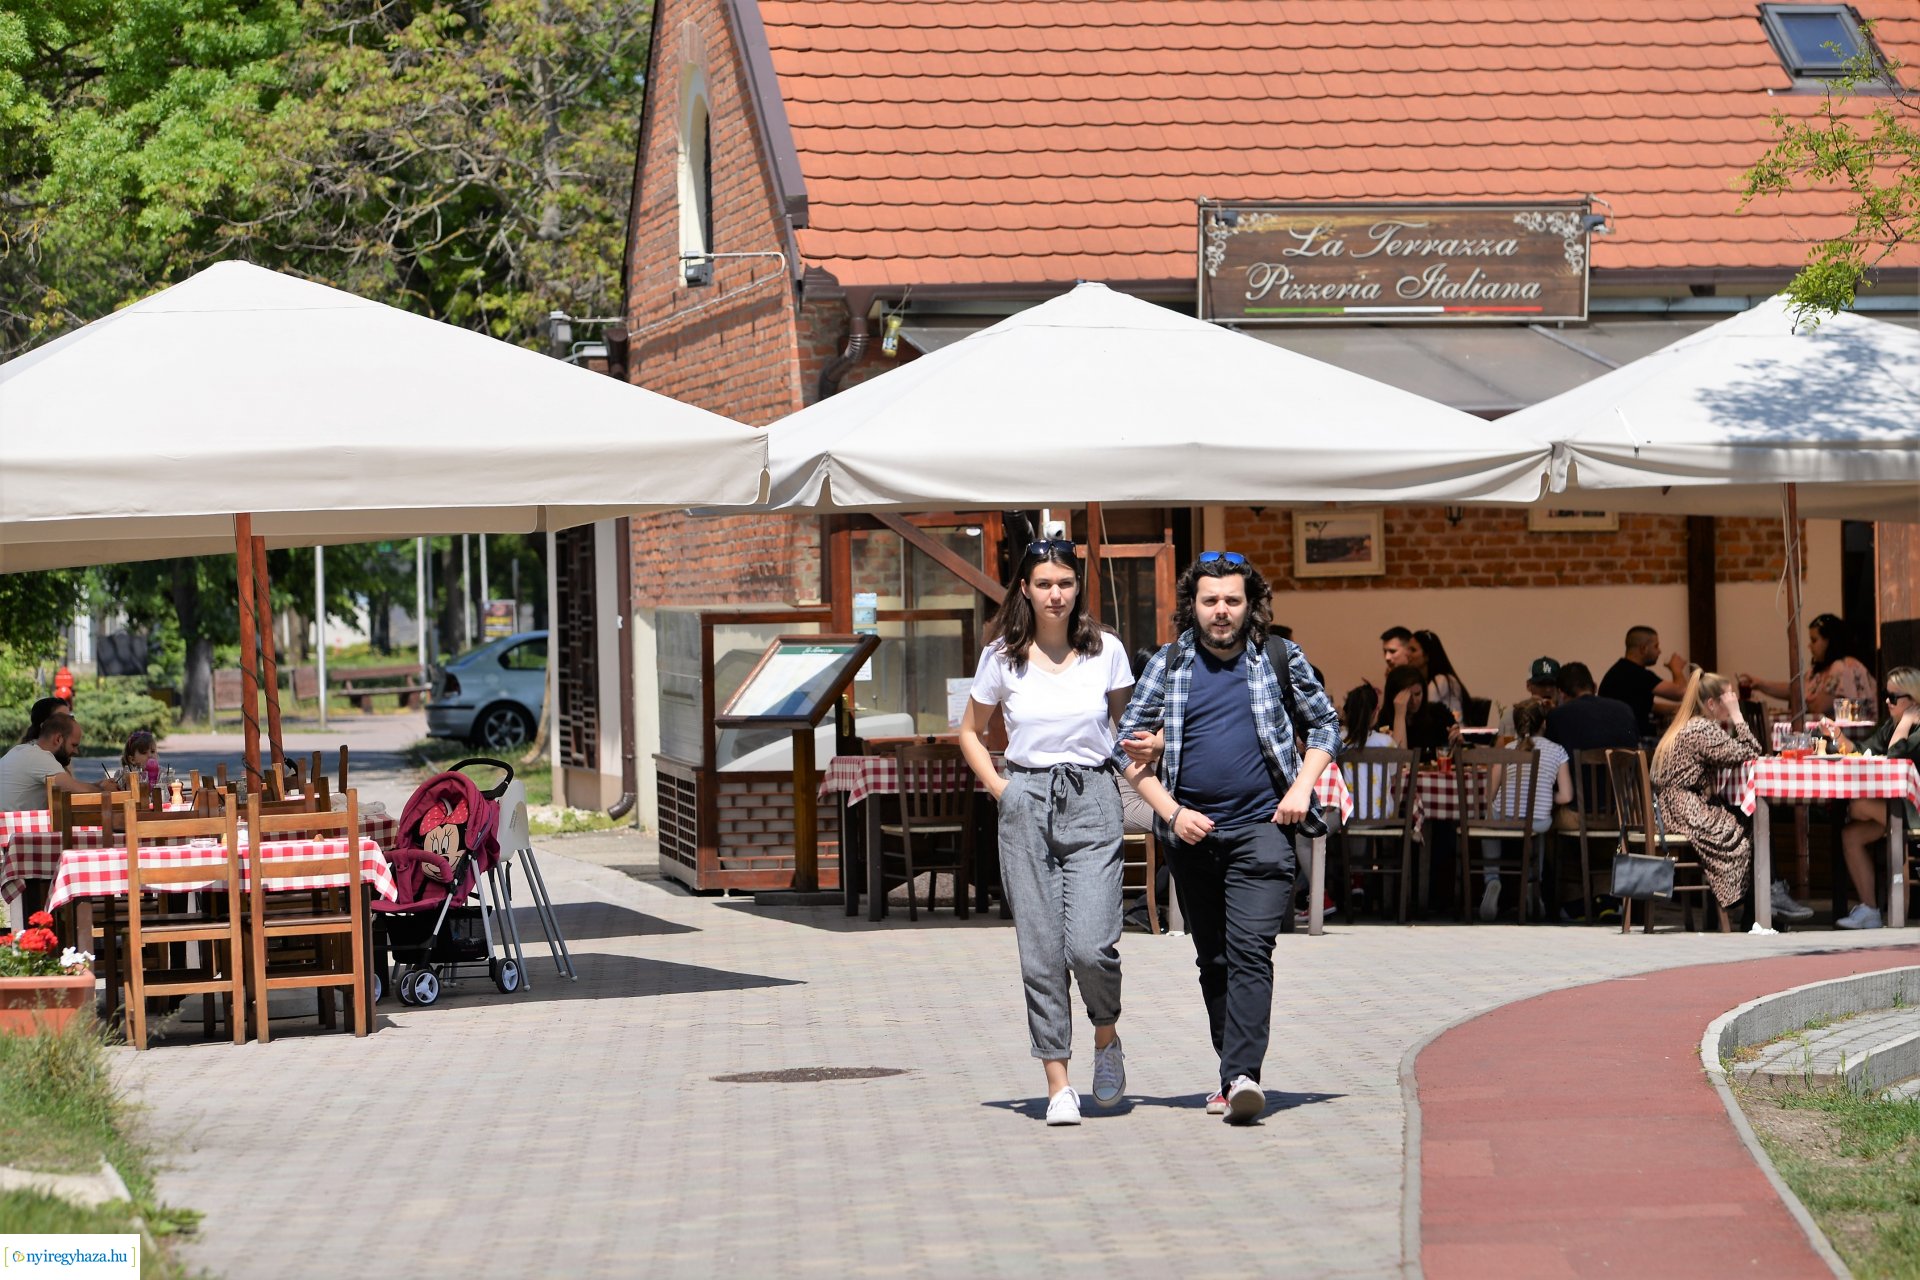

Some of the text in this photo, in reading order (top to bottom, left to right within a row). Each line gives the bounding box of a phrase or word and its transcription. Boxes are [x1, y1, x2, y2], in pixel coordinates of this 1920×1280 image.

[1282, 220, 1519, 258] La Terrazza
[1245, 262, 1543, 301] Pizzeria Italiana
